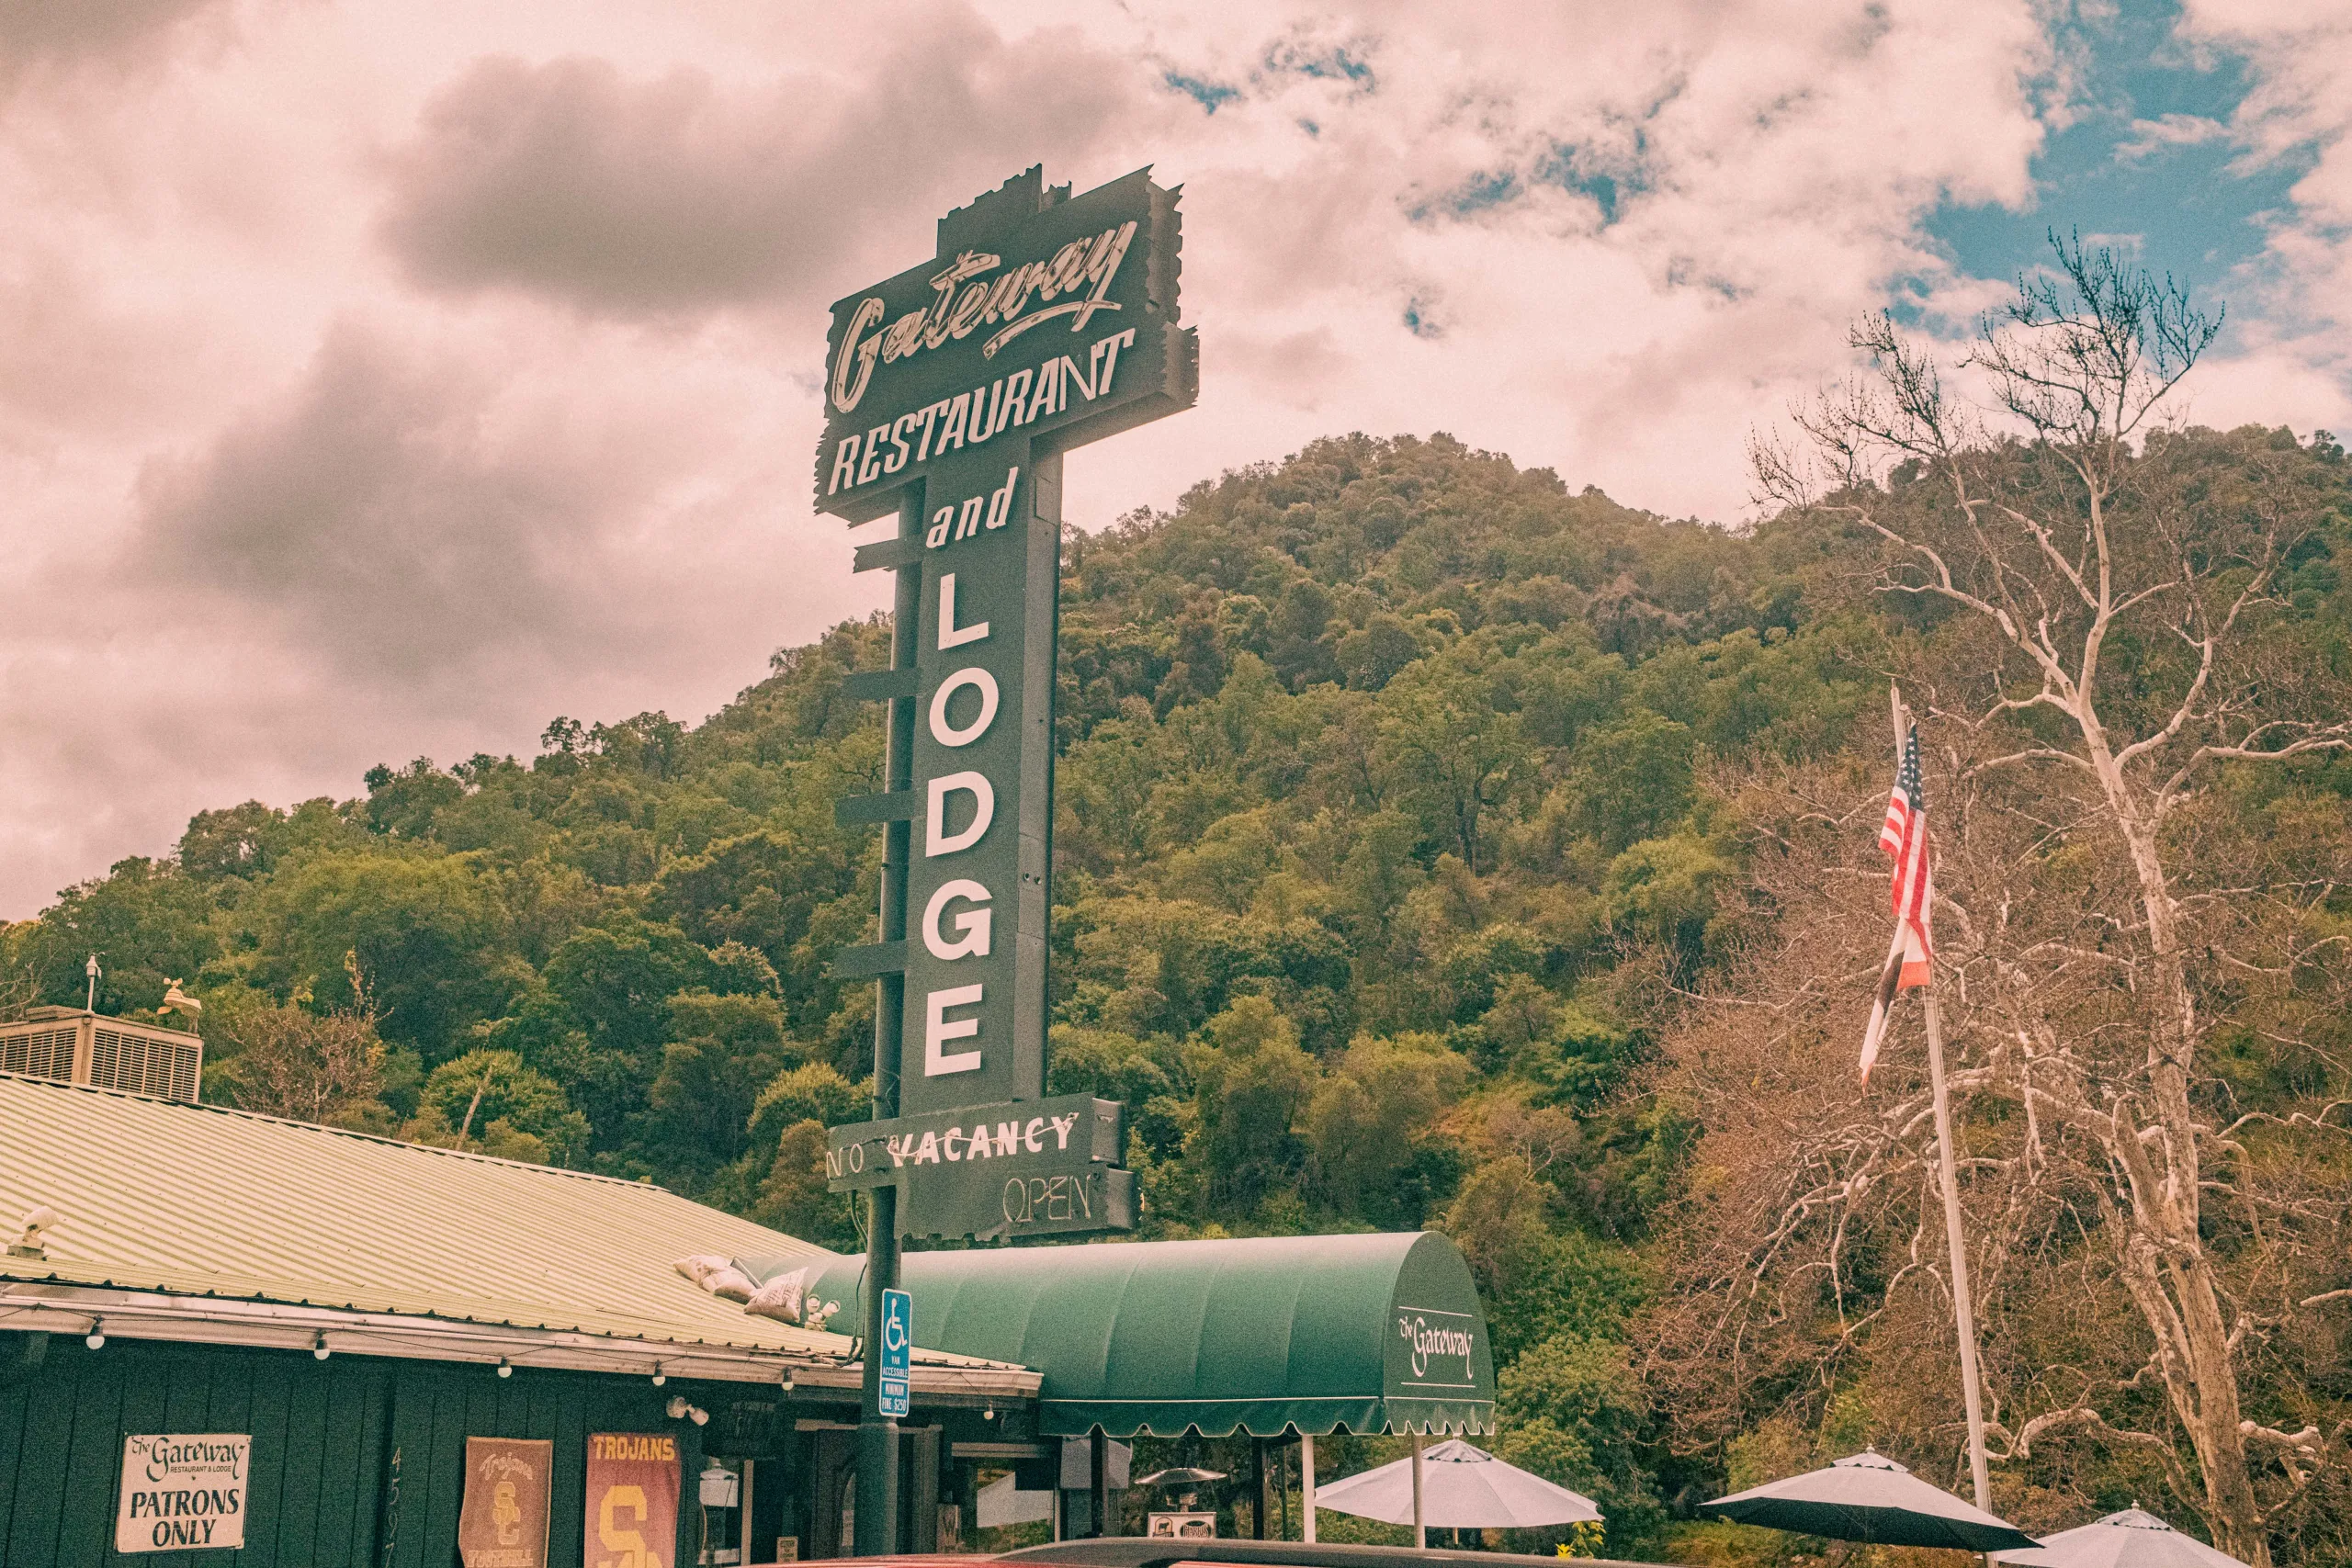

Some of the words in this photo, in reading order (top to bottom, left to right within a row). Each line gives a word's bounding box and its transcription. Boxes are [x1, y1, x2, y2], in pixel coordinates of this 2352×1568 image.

[831, 220, 1137, 413] Gateway
[827, 328, 1136, 496] RESTAURANT
[926, 467, 1019, 548] and
[922, 572, 1000, 1077] LODGE
[827, 1143, 864, 1180] NO
[888, 1112, 1080, 1168] VACANCY
[1002, 1174, 1091, 1224] OPEN
[891, 1356, 900, 1366] VAN
[1398, 1315, 1413, 1340] The
[1412, 1316, 1474, 1380] Gateway
[882, 1368, 909, 1378] ACCESSIBLE
[885, 1383, 905, 1396] MINIMUM
[882, 1397, 892, 1410] FINE
[894, 1398, 907, 1412] $250
[131, 1437, 151, 1455] The
[146, 1437, 245, 1482] Gateway
[593, 1436, 676, 1461] TROJANS
[130, 1489, 240, 1518] PATRONS
[153, 1519, 217, 1547] ONLY
